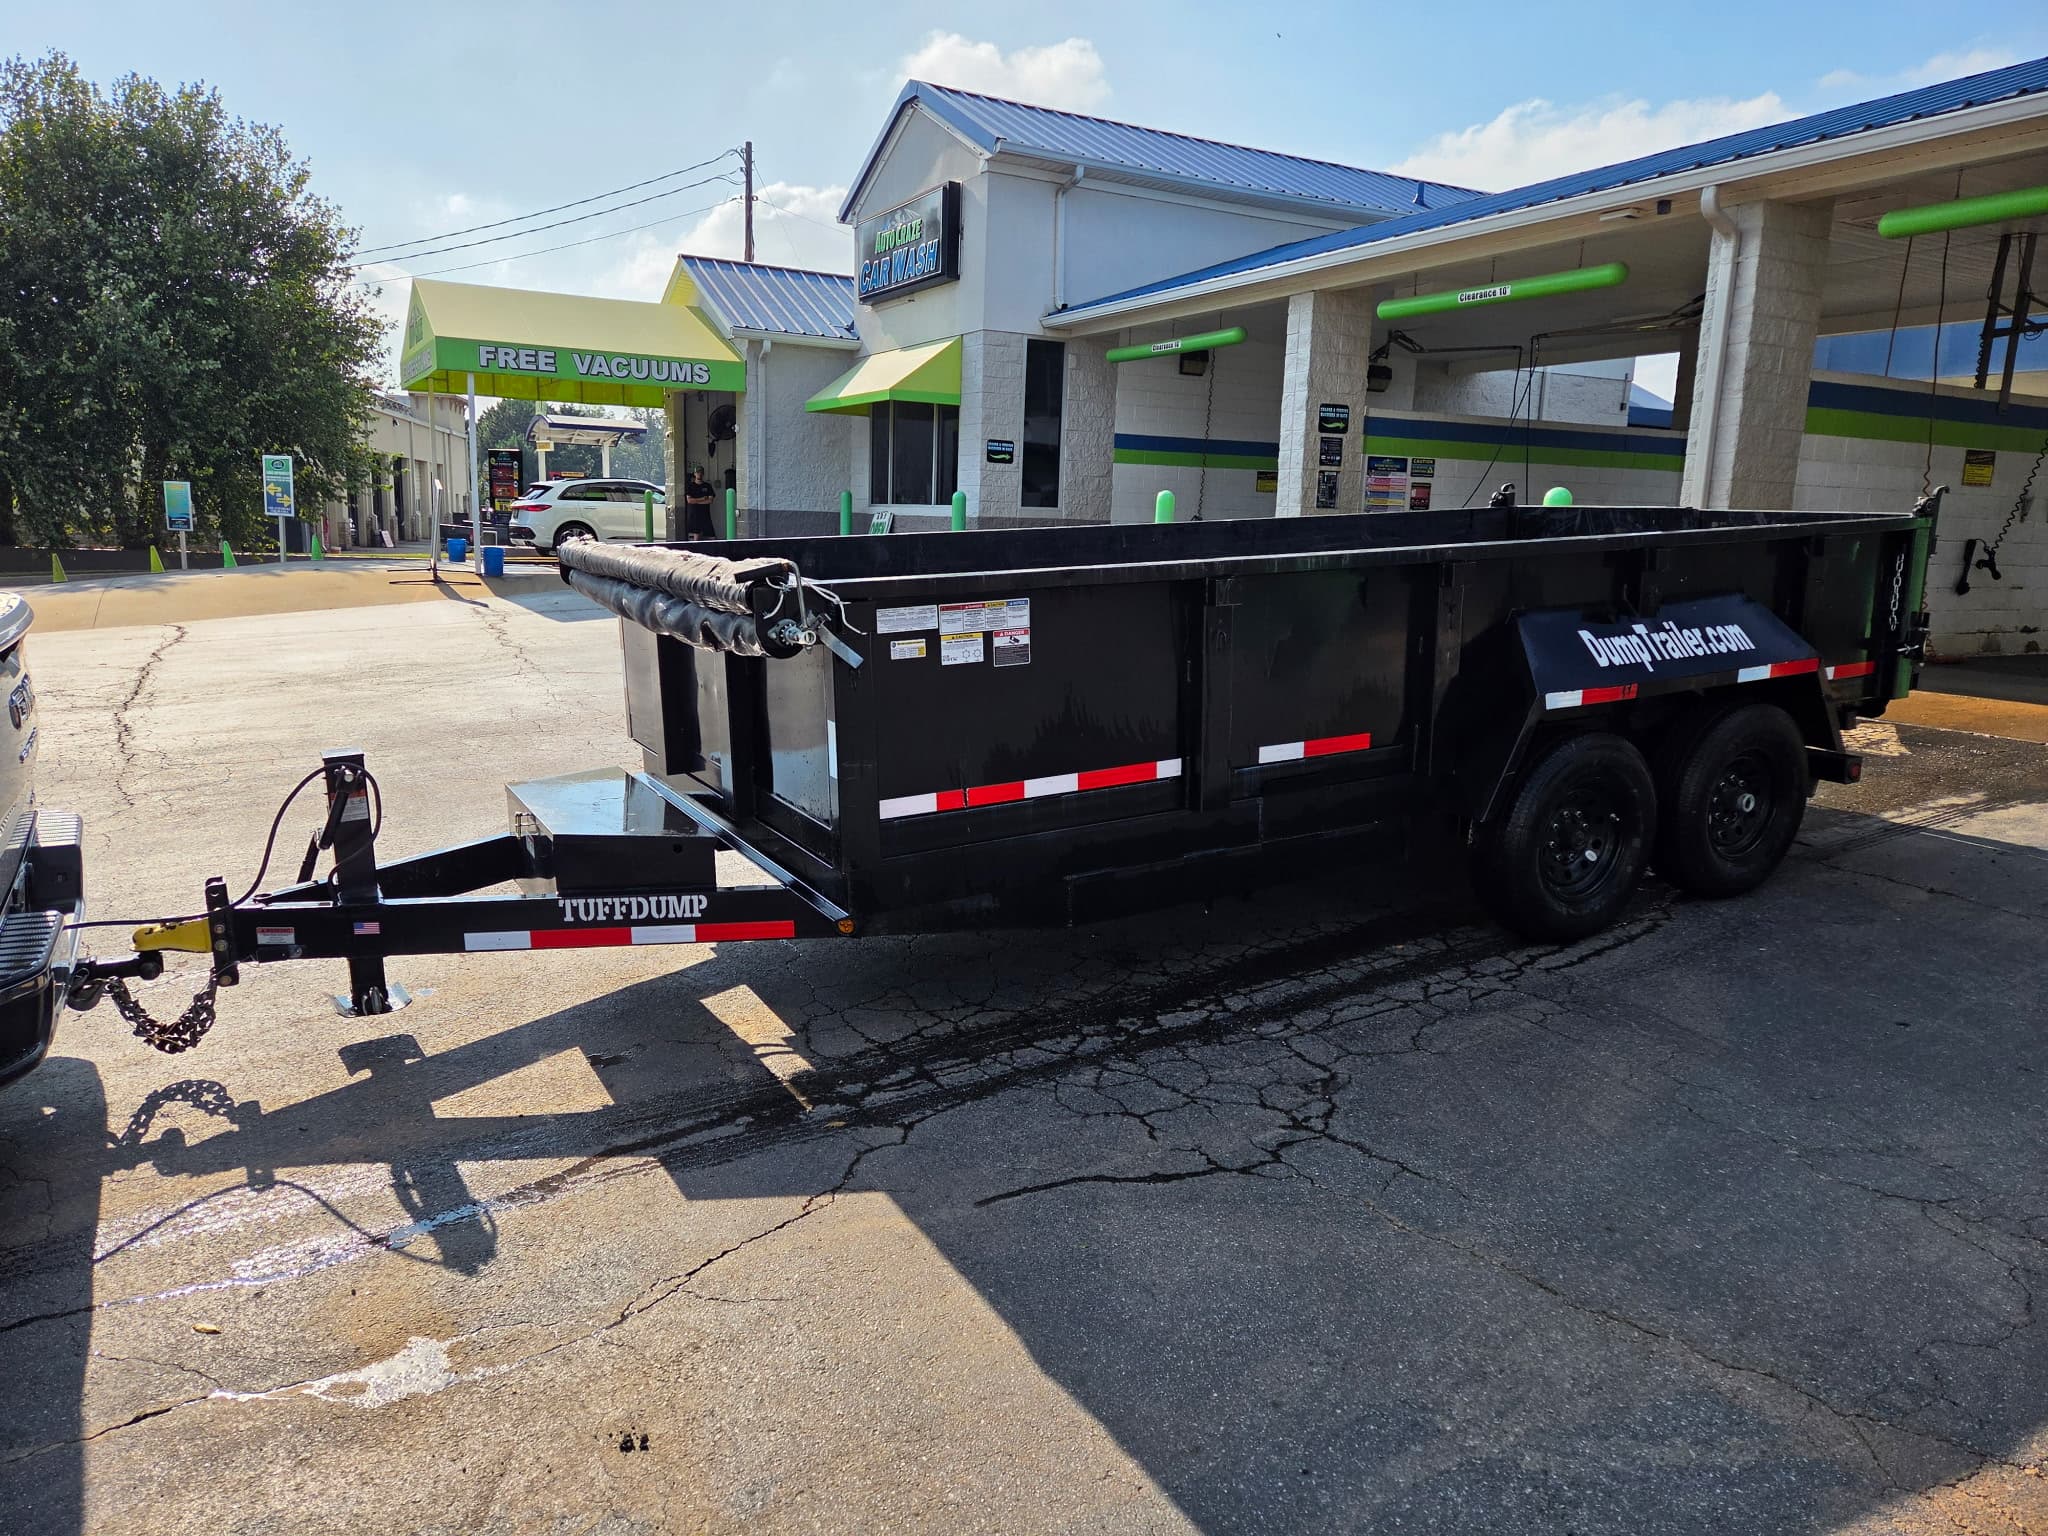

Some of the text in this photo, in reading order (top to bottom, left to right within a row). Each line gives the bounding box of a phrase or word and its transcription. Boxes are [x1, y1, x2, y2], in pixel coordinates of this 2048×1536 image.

[875, 218, 923, 255] AUTO CRAZE
[860, 238, 940, 294] CAR WASH
[1459, 289, 1497, 302] Clearance
[478, 344, 711, 385] FREE VACUUMS
[1577, 620, 1756, 672] DumpTrailer.com
[558, 894, 708, 922] TUFFDUMP
